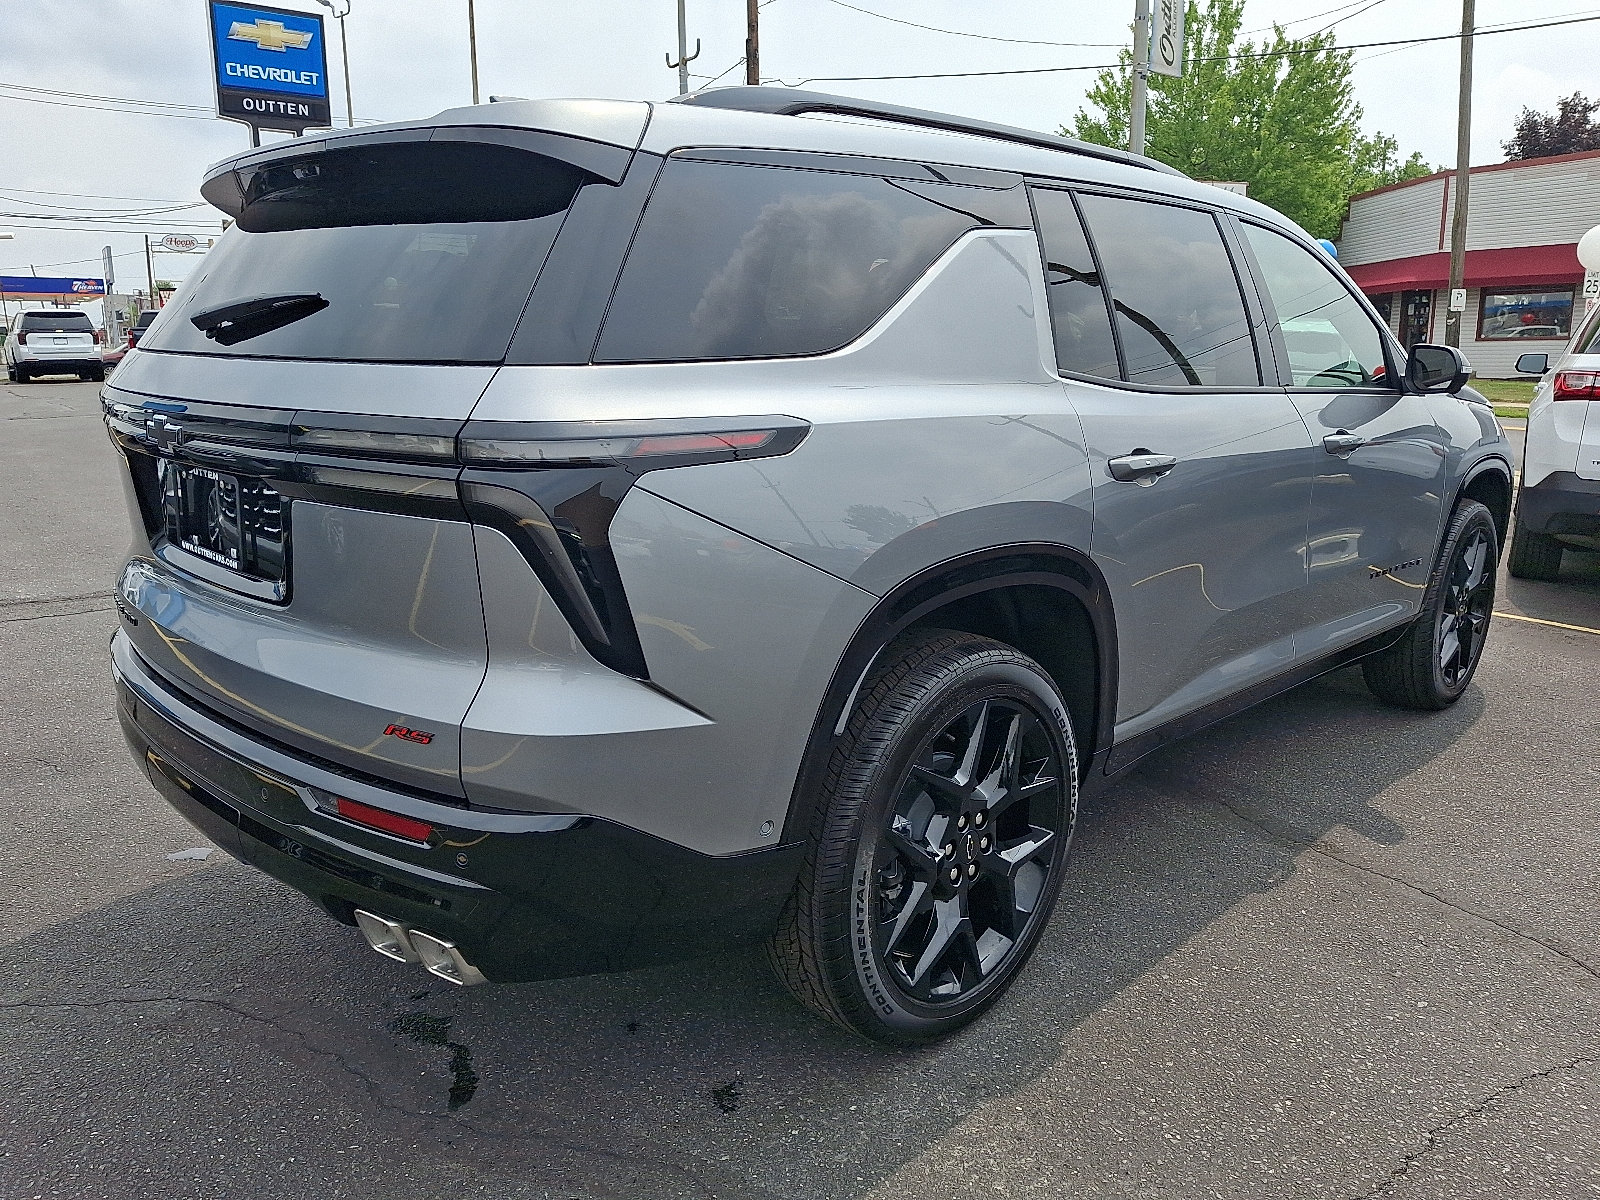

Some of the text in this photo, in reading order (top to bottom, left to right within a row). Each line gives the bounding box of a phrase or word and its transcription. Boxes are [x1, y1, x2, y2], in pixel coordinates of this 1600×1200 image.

[225, 62, 319, 86] CHEVROLET
[242, 97, 309, 117] OUTTEN
[1585, 279, 1599, 294] 25
[383, 723, 436, 745] RS
[856, 870, 895, 1016] CONTINENTAL
